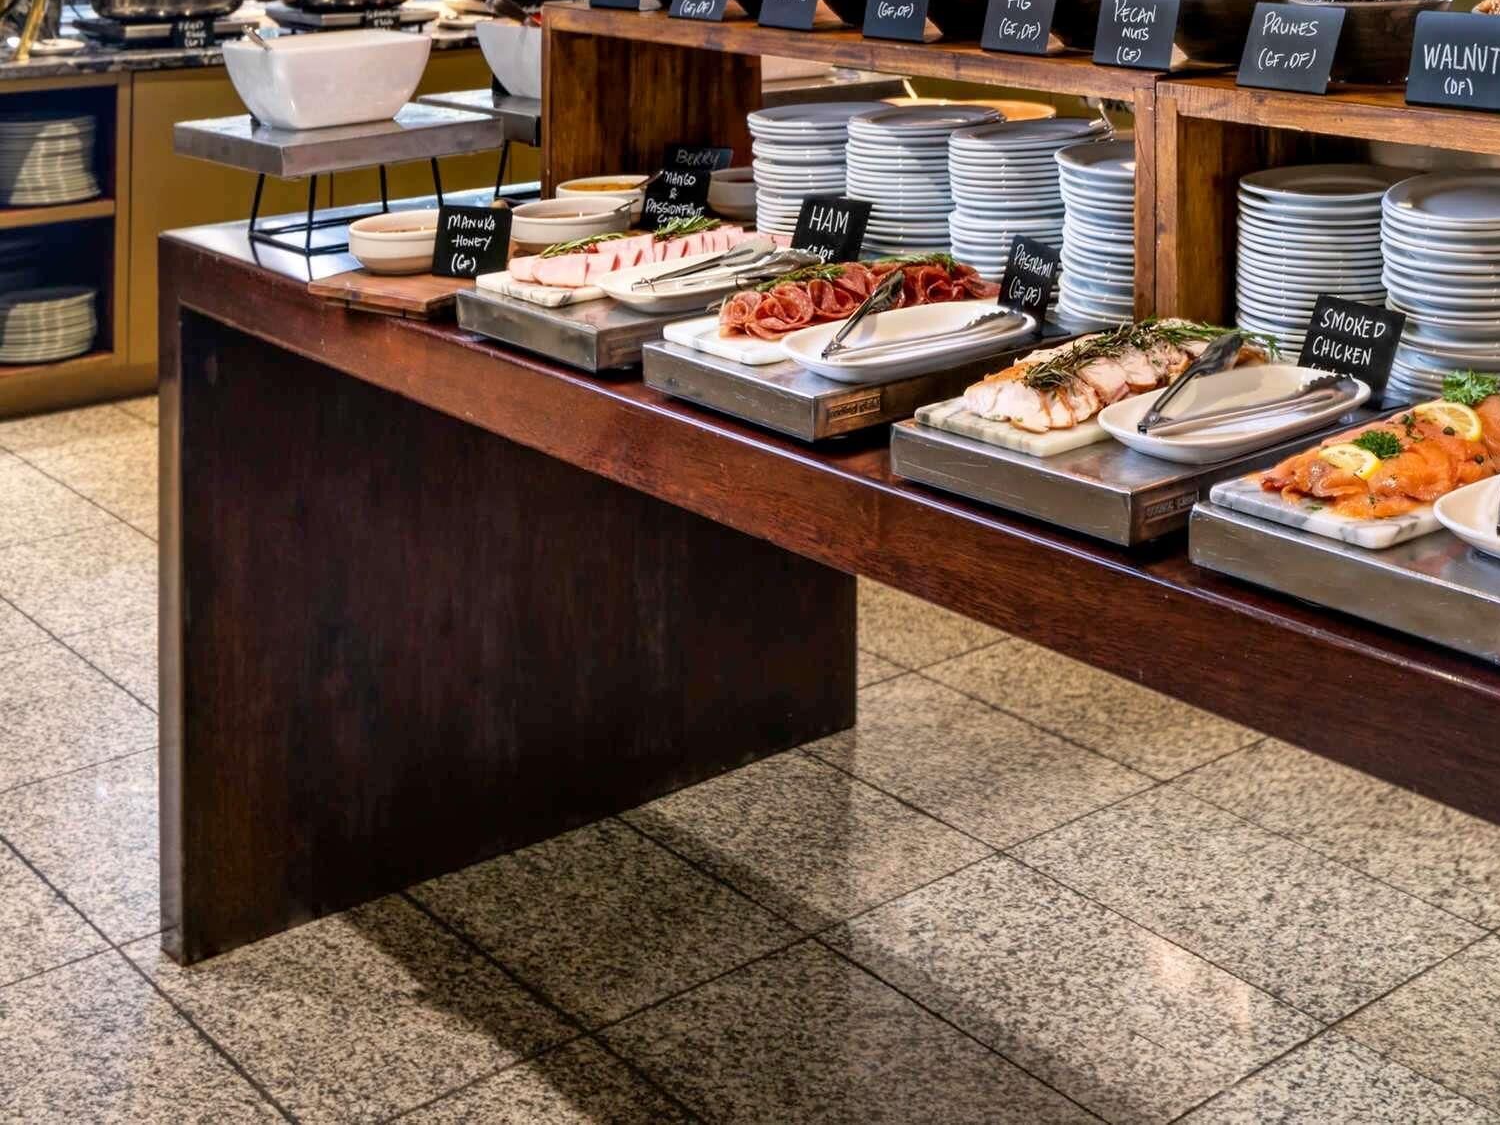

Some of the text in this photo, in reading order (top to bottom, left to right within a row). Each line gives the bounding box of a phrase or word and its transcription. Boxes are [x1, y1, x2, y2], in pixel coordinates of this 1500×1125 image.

[1262, 11, 1319, 36] PRUNES
[1121, 27, 1150, 41] NUTS
[1116, 46, 1142, 64] (GF)
[1444, 76, 1473, 96] (DF)
[675, 148, 721, 170] BERRY
[664, 170, 697, 186] MANGO
[669, 187, 678, 200] &
[447, 214, 496, 231] MANUKA
[808, 205, 850, 234] HAM
[451, 233, 492, 251] HONEY
[451, 253, 477, 272] (GF)
[1013, 244, 1054, 278] PASTRAMI
[1320, 308, 1386, 339] SMOKED
[1312, 335, 1373, 366] CHICKEN
